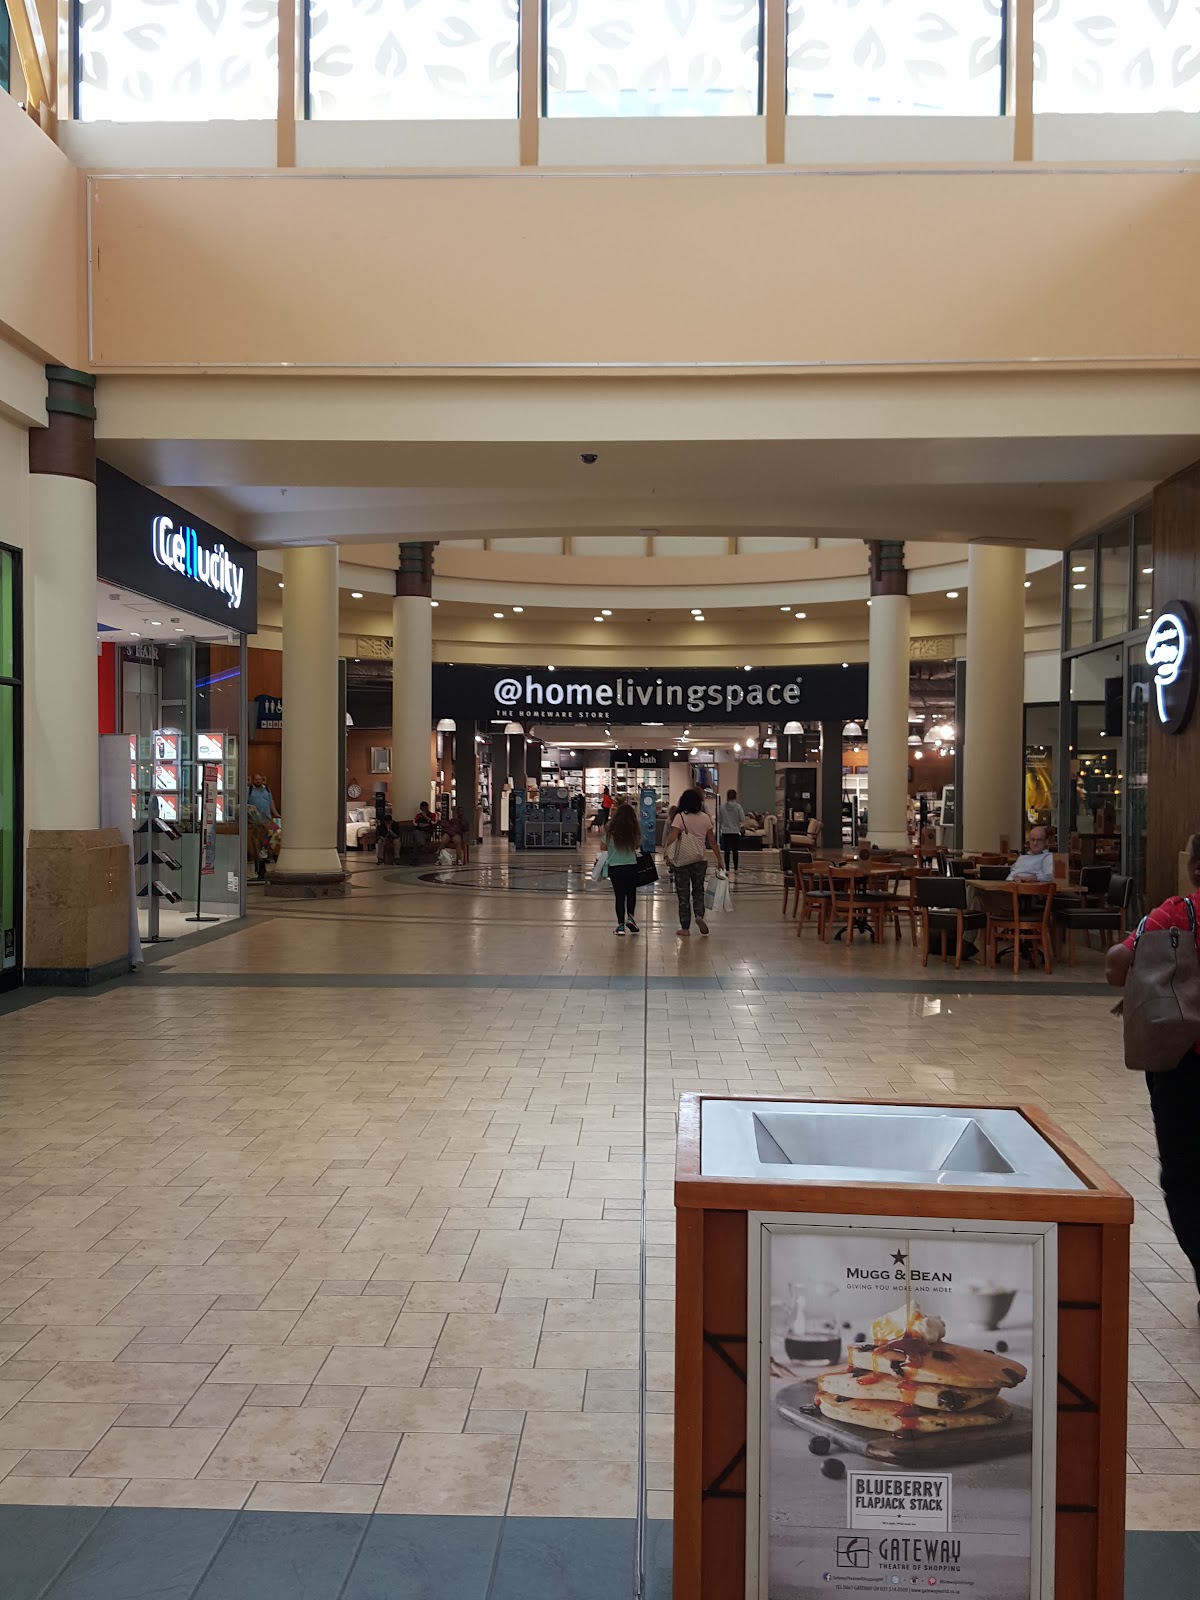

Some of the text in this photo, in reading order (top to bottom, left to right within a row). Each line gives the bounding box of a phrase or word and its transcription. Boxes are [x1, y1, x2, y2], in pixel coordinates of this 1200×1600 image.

[153, 516, 244, 609] Cellucity
[519, 710, 573, 718] HOMEWARE
[578, 711, 610, 719] STORE
[639, 755, 657, 764] bath
[855, 1478, 943, 1498] BLUEBERRY
[855, 1496, 943, 1511] FLAPJACK STACK
[878, 1538, 961, 1563] GATEWAY
[879, 1563, 909, 1571] THEATRE
[923, 1564, 961, 1572] SHOPPING
